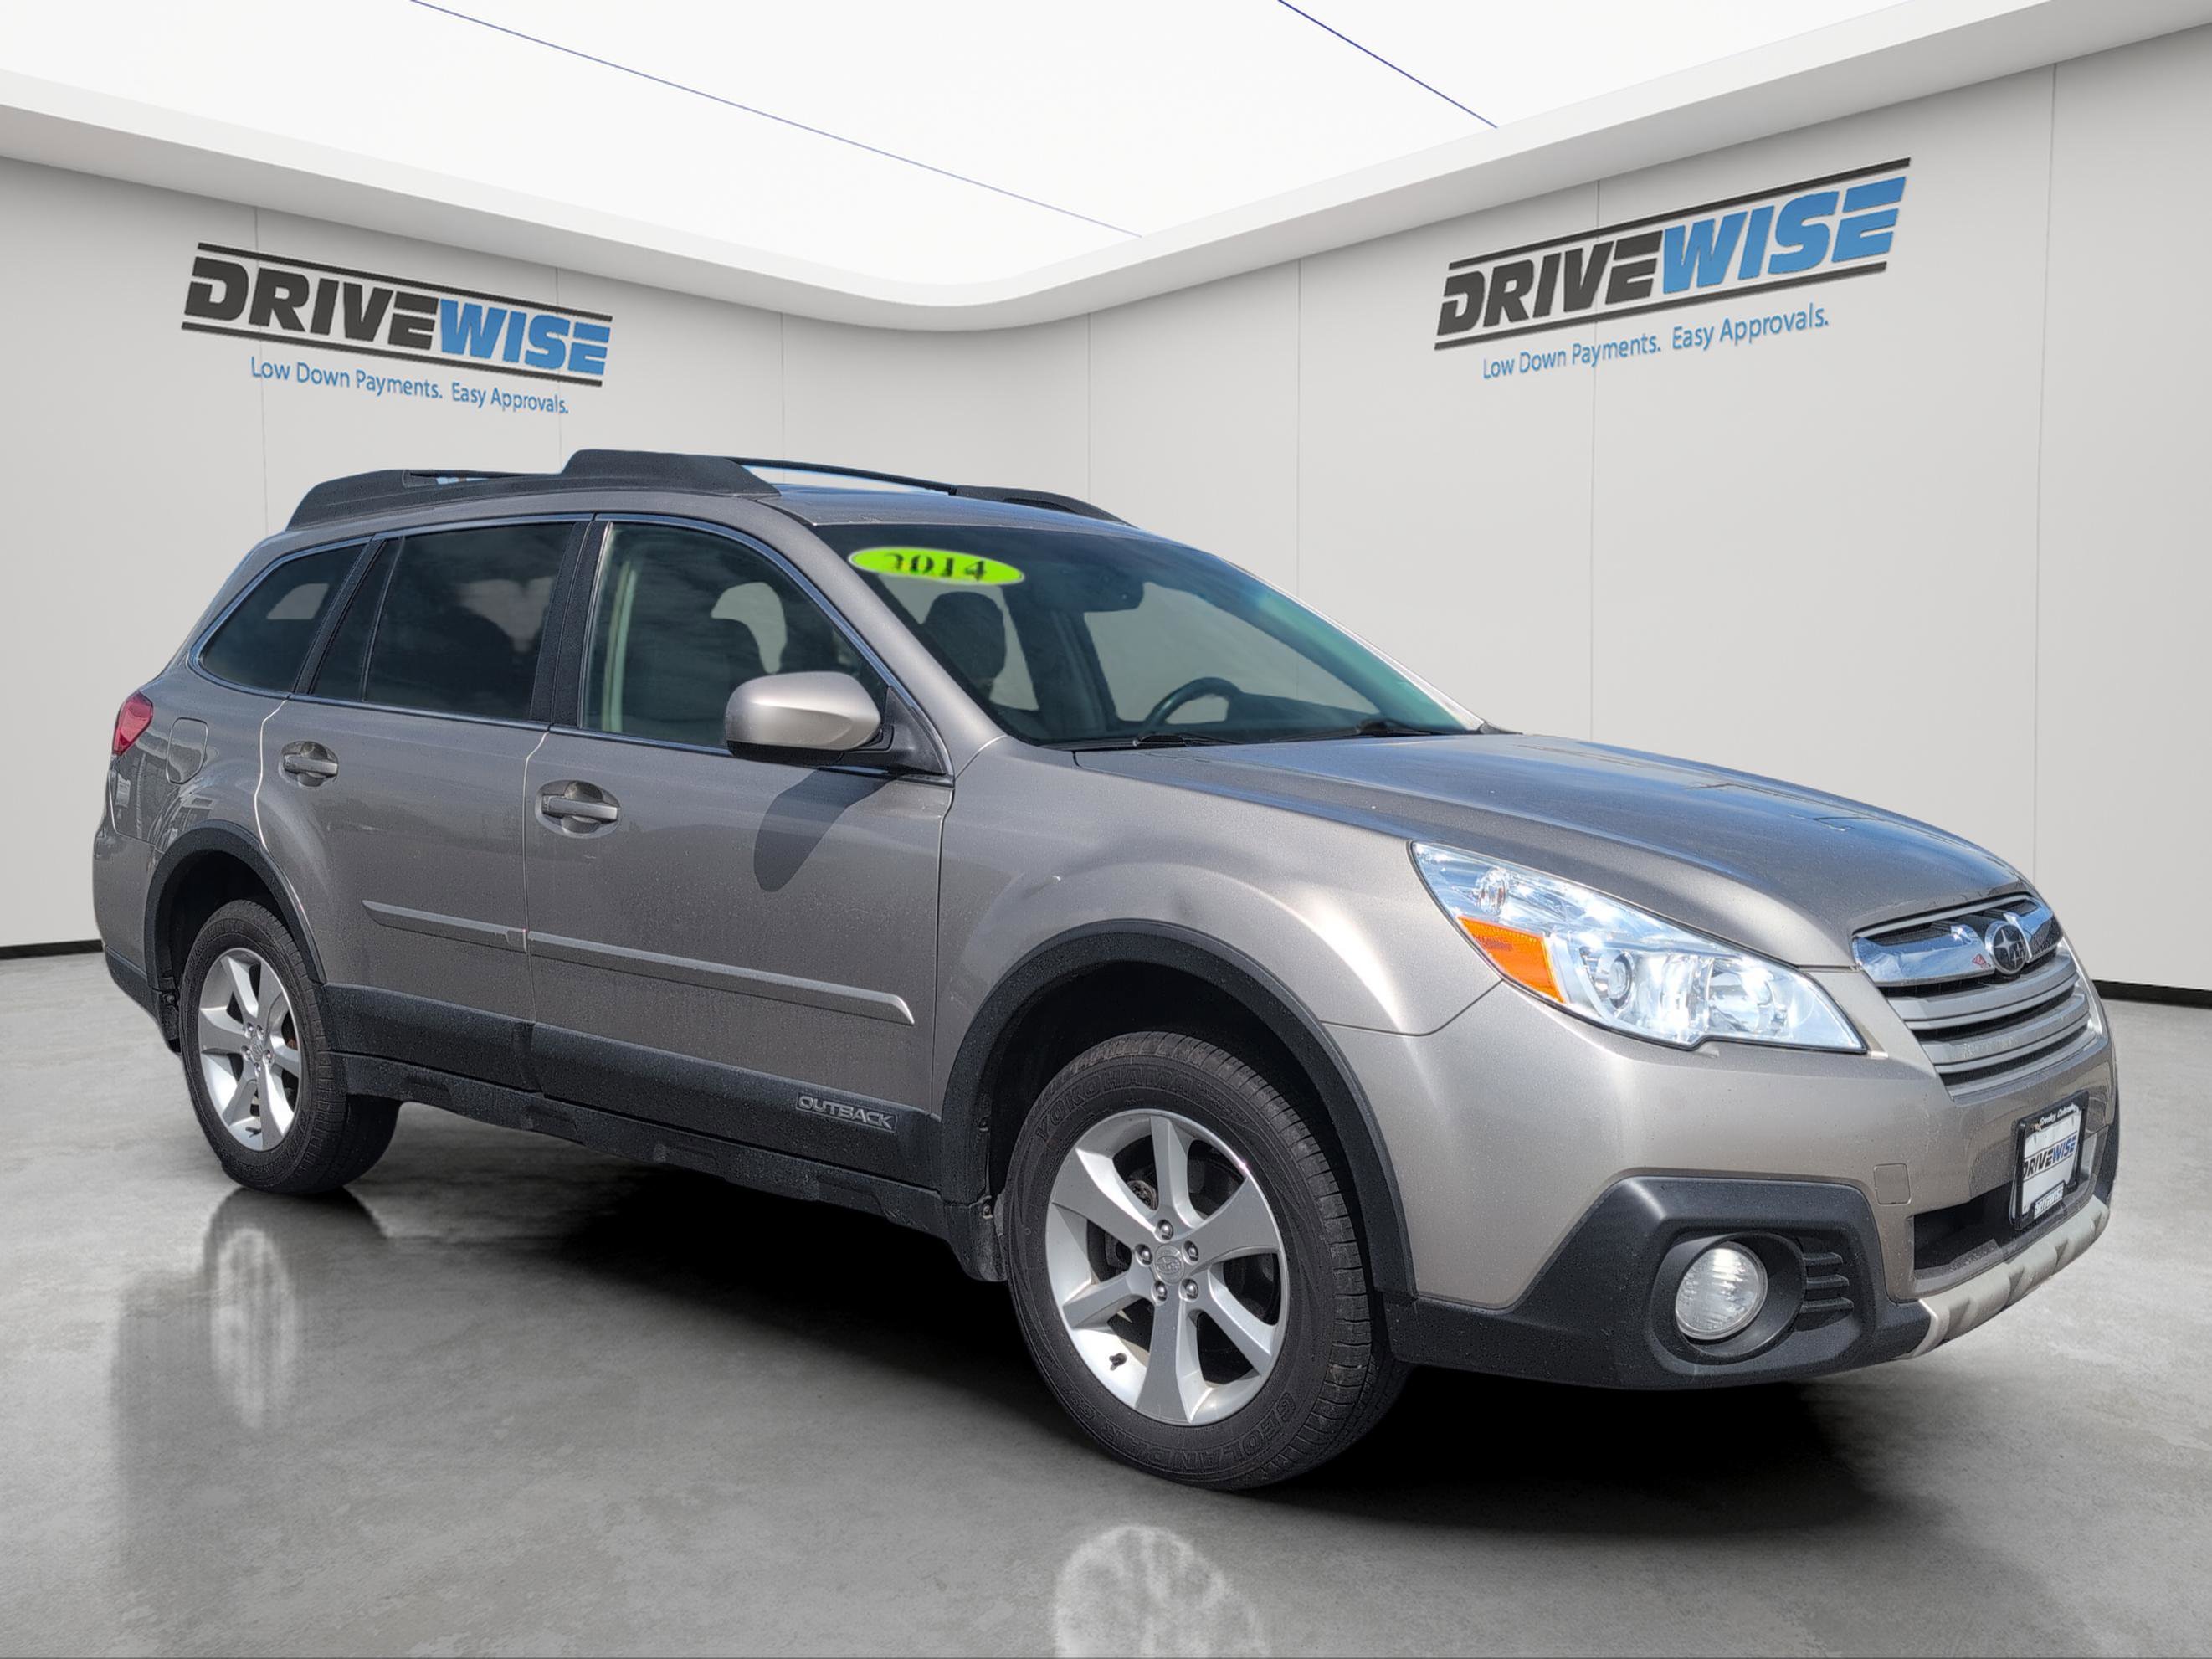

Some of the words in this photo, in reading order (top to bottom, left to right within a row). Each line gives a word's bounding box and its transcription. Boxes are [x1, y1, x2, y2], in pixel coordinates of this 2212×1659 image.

[1436, 176, 1907, 336] DRIVEWISE
[184, 256, 610, 376] DRIVEWISE
[1482, 357, 1515, 379] Low
[1519, 348, 1567, 373] Down
[1572, 333, 1661, 367] Payments.
[1673, 322, 1715, 352] Easy
[1720, 302, 1830, 343] Approvals.
[251, 356, 290, 381] Low
[296, 362, 350, 388] Down
[357, 370, 443, 400] Payments.
[452, 383, 486, 408] Easy
[490, 388, 569, 414] Approvals.
[884, 552, 987, 581] 2014
[798, 1095, 894, 1130] OUTBACK
[2022, 1135, 2077, 1178] DRIVEWISE
